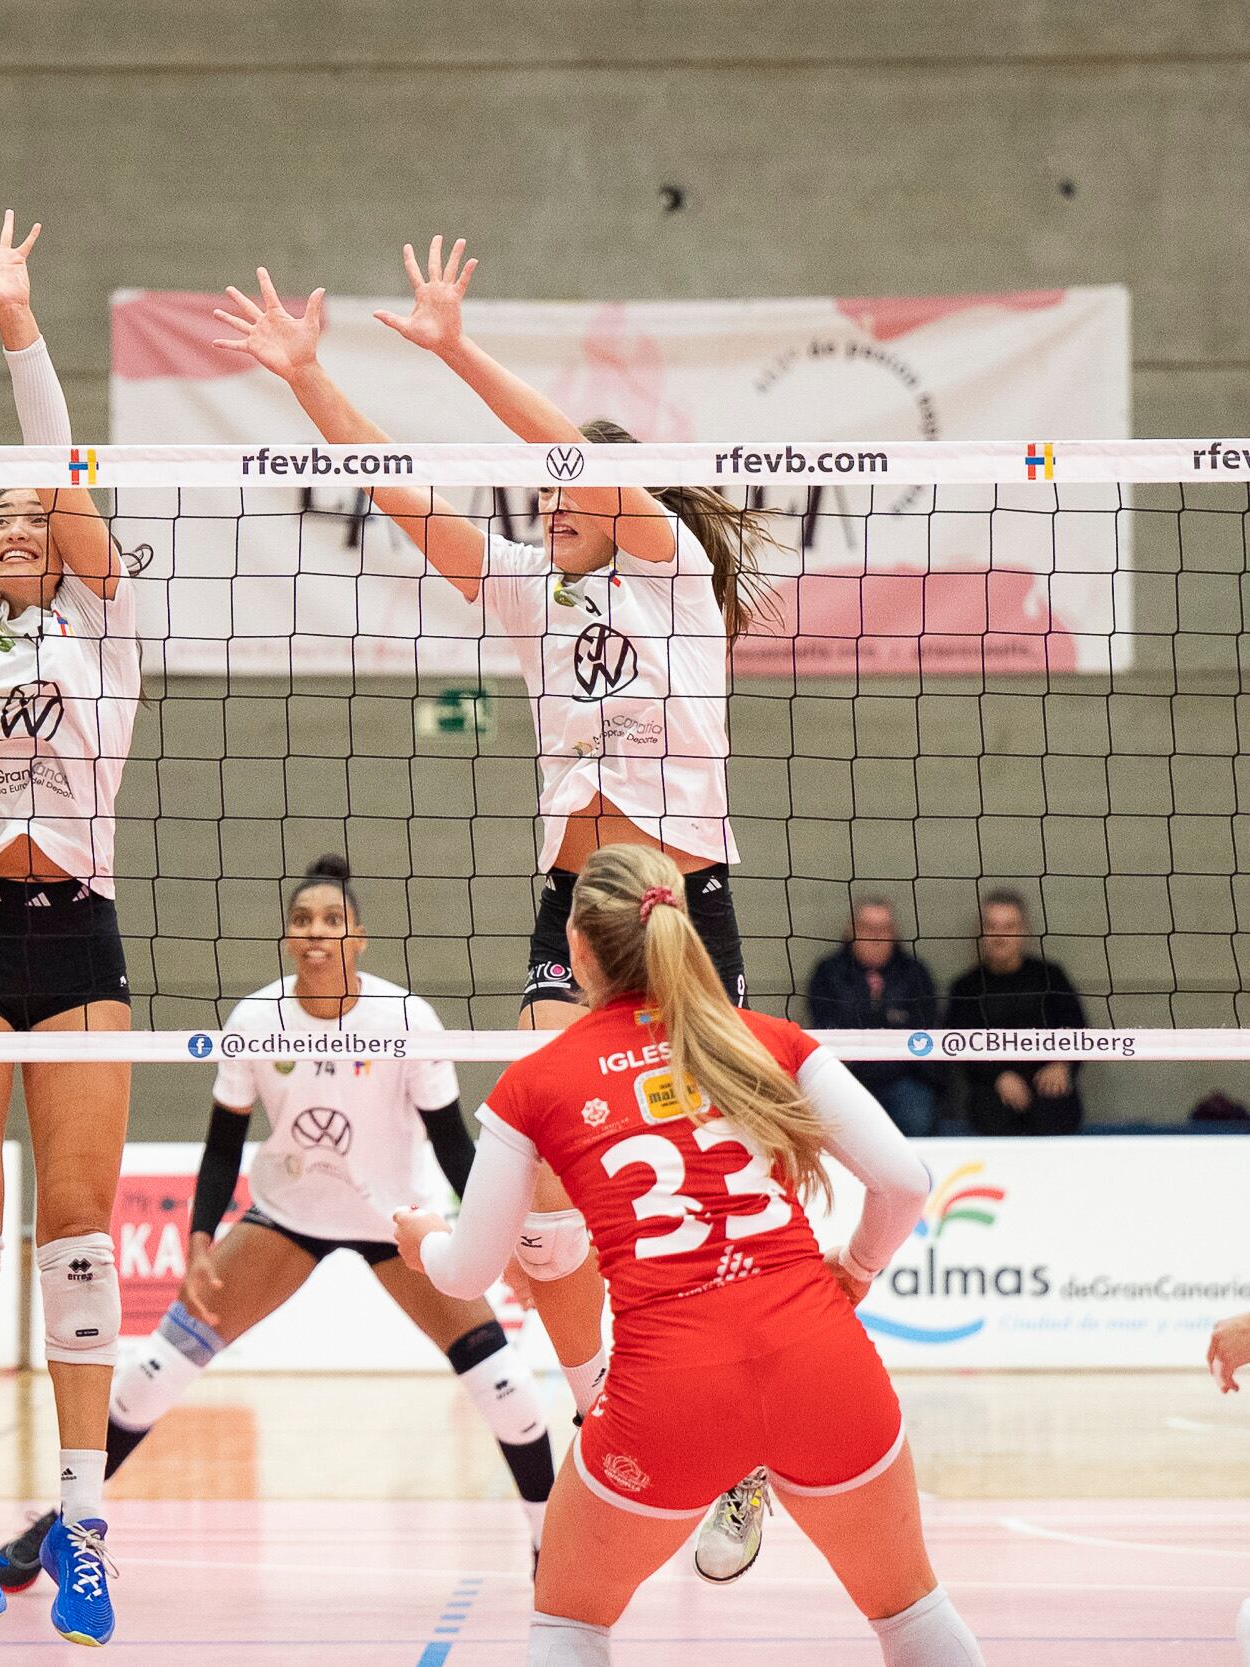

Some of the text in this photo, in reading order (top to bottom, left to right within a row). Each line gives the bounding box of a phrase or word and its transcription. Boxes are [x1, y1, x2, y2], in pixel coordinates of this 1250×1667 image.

[242, 448, 413, 475] rfevb.com
[715, 445, 888, 473] rfevb.com
[221, 1033, 407, 1057] @cdheidelberg
[598, 1041, 671, 1075] IGLES
[941, 1032, 1136, 1056] @CBHeidelberg
[600, 1120, 792, 1259] 33
[874, 1246, 1050, 1297] almas
